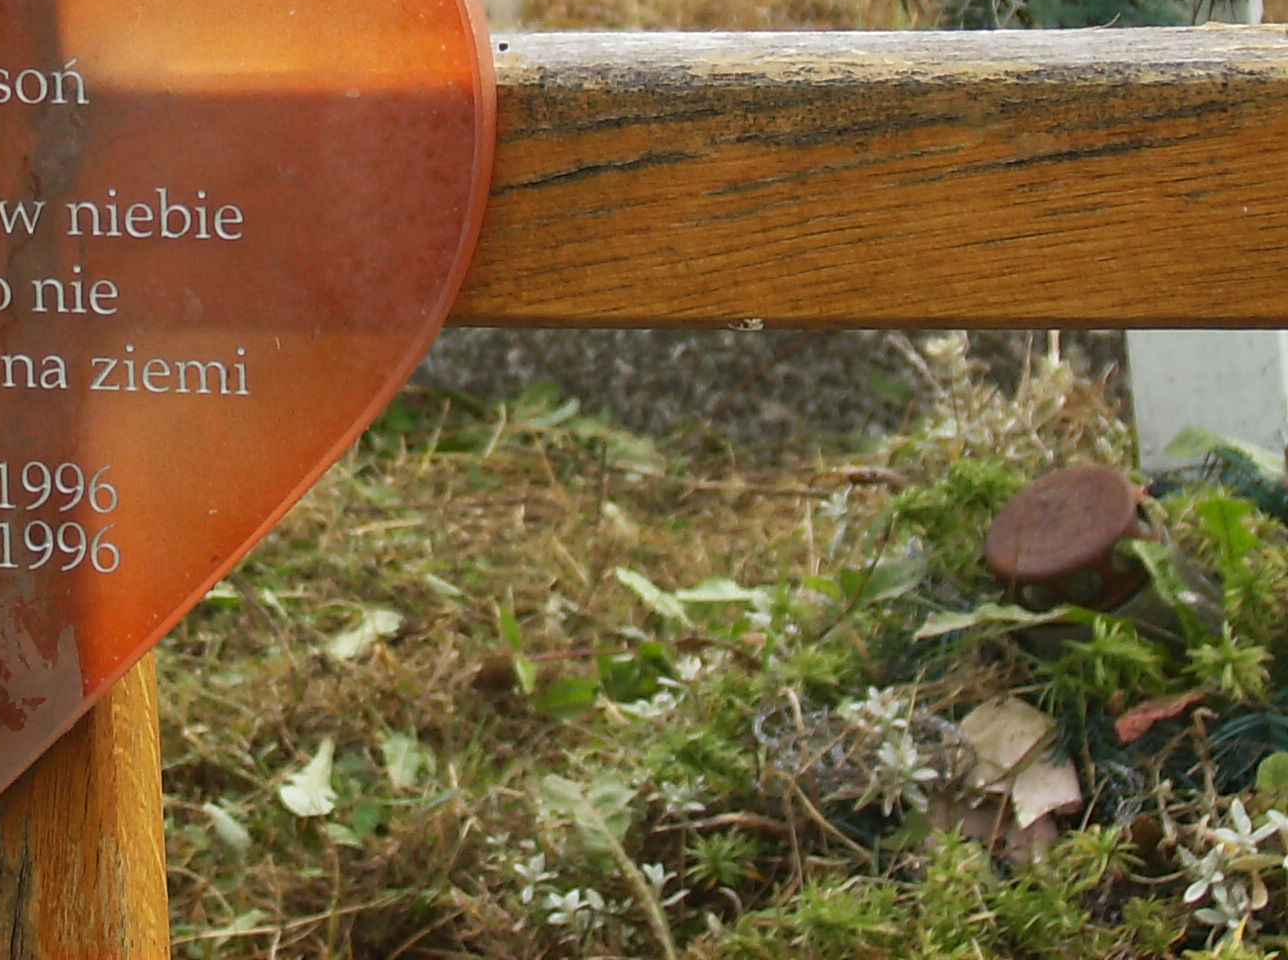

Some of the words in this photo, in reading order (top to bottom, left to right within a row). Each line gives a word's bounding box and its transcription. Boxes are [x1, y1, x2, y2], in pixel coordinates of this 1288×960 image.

[67, 188, 244, 241] niebie
[32, 265, 119, 316] nie
[2, 353, 68, 390] na
[90, 344, 249, 395] ziemi
